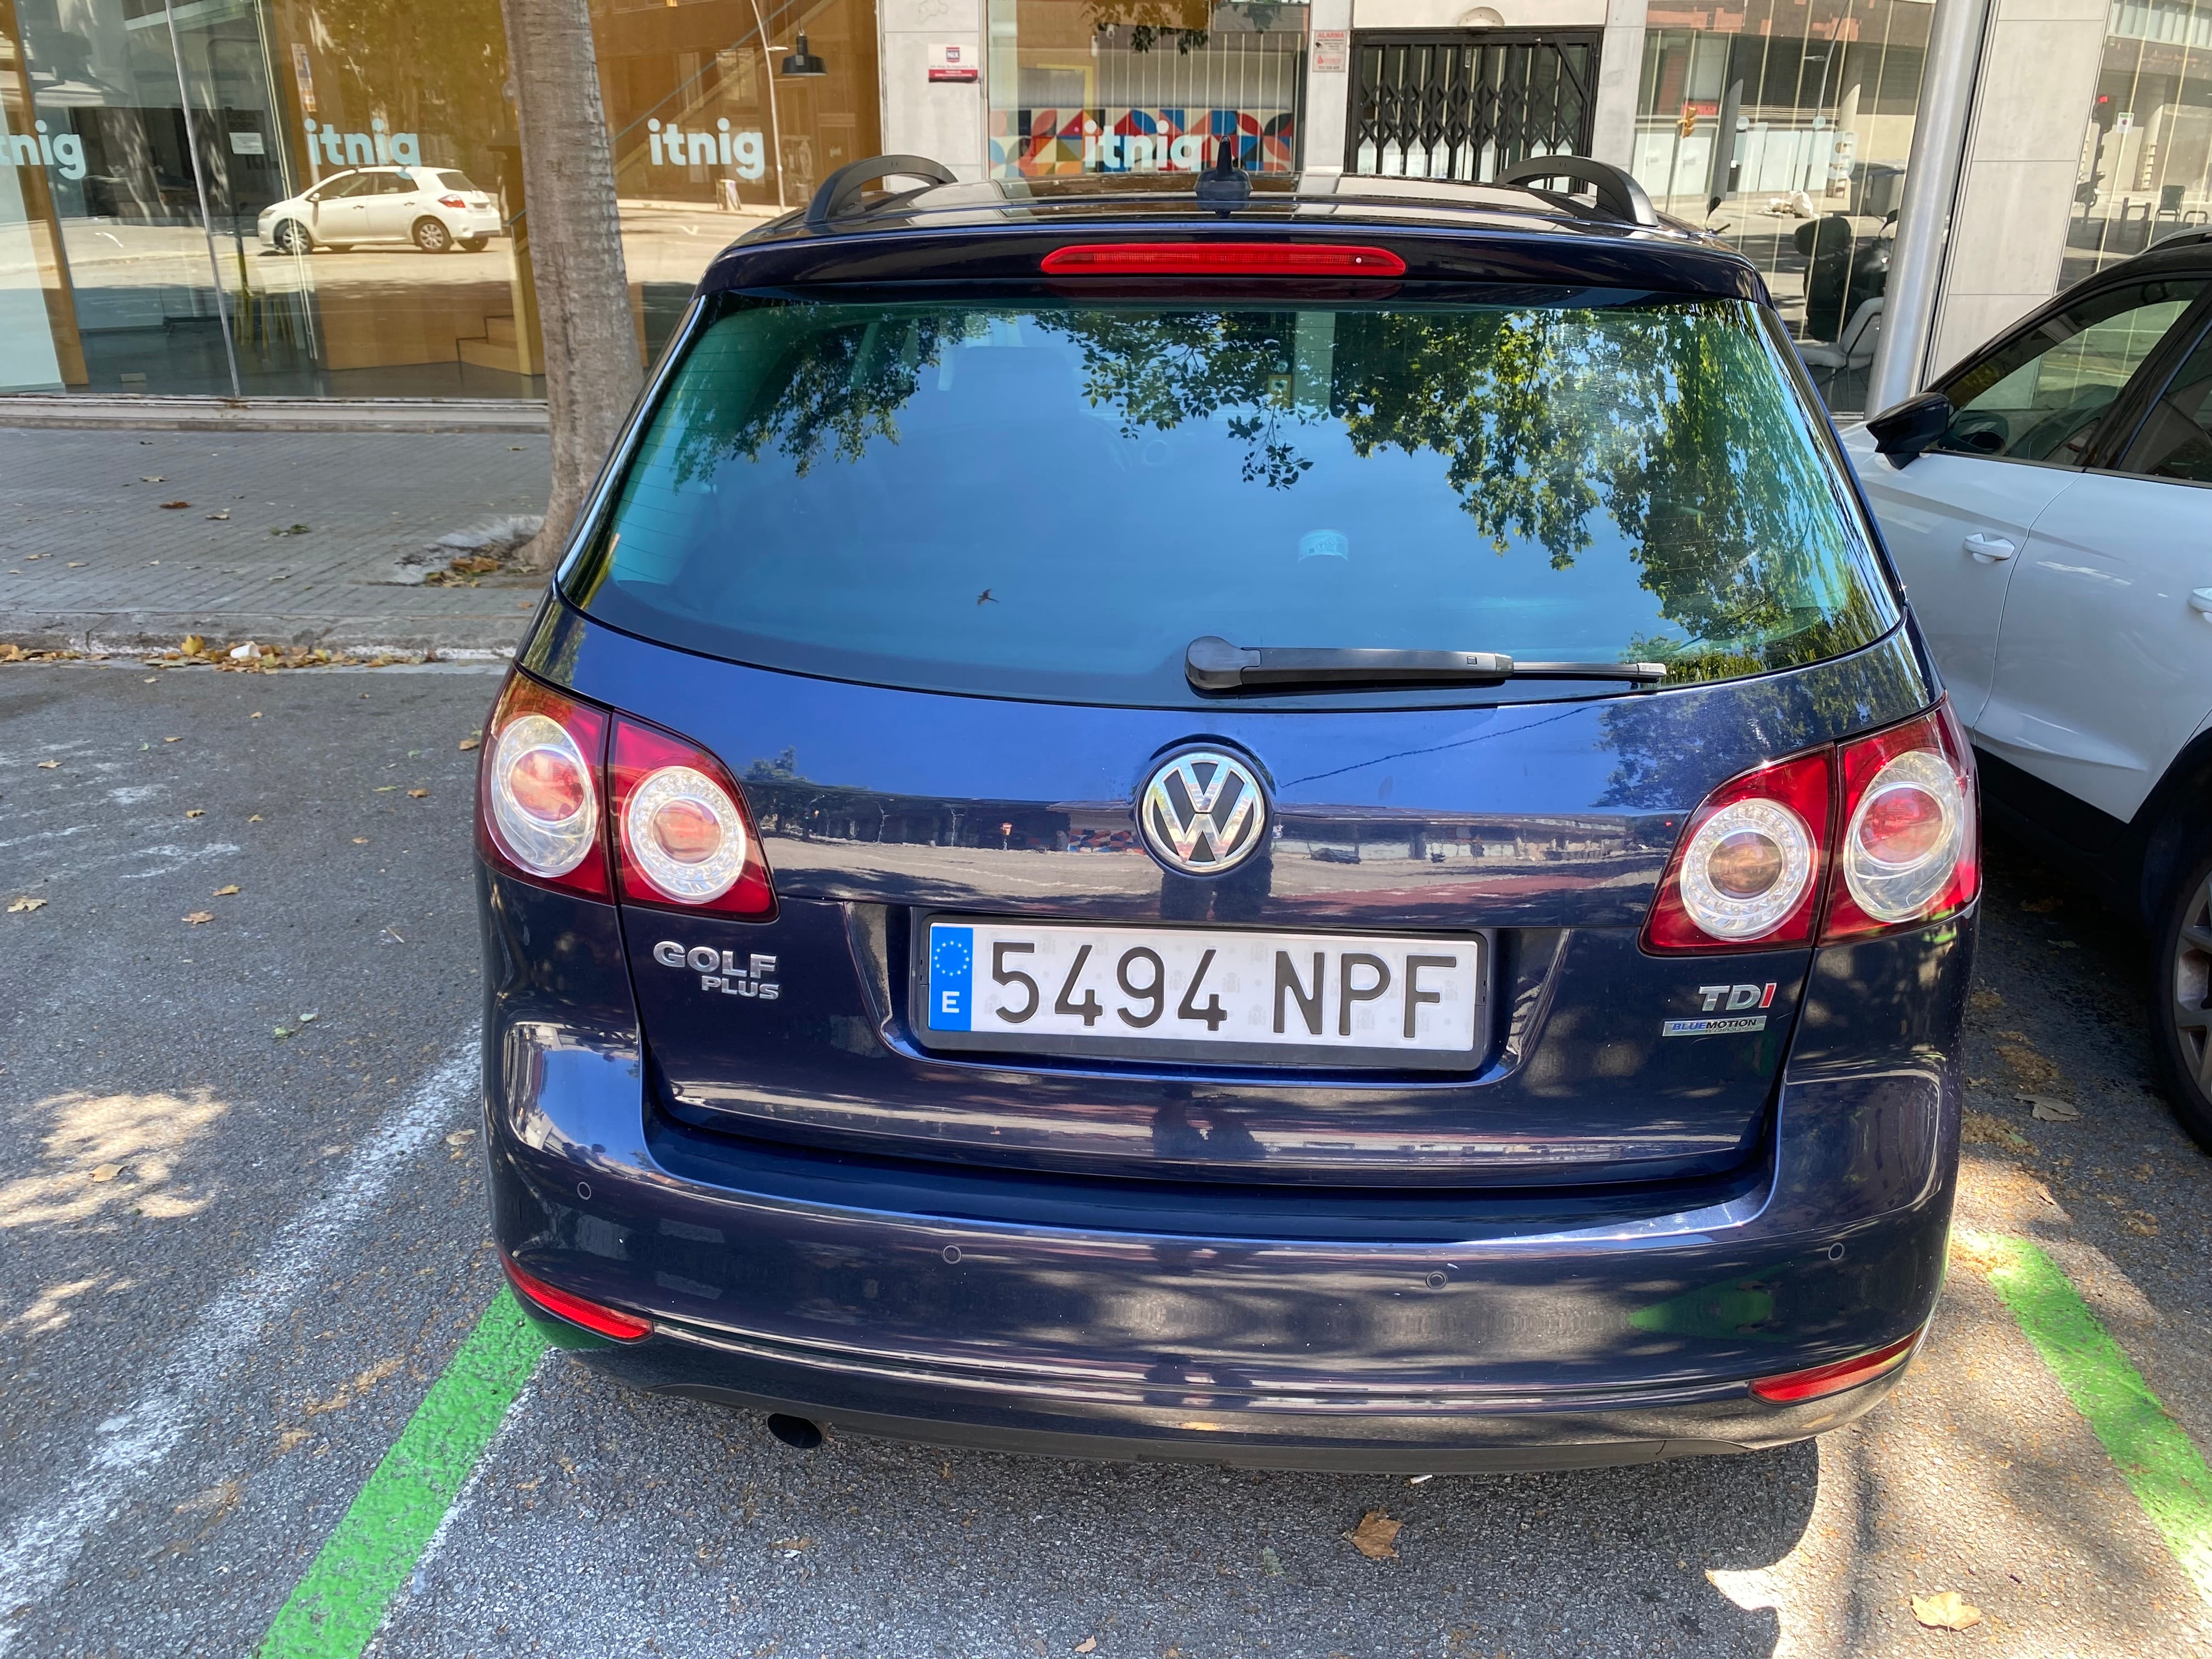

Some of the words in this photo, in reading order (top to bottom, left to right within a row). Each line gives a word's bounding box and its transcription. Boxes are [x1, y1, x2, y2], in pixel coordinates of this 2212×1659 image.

[304, 118, 422, 180] itnig
[647, 117, 765, 180] itnig
[1084, 120, 1202, 172] itnig
[653, 940, 777, 979] GOLF
[701, 975, 781, 1000] PLUS
[941, 990, 960, 1013] E
[992, 941, 1228, 1031] 5494
[1272, 950, 1458, 1039] NPF
[1699, 983, 1777, 1011] TDI
[1672, 1019, 1757, 1030] BLUEMOTION
